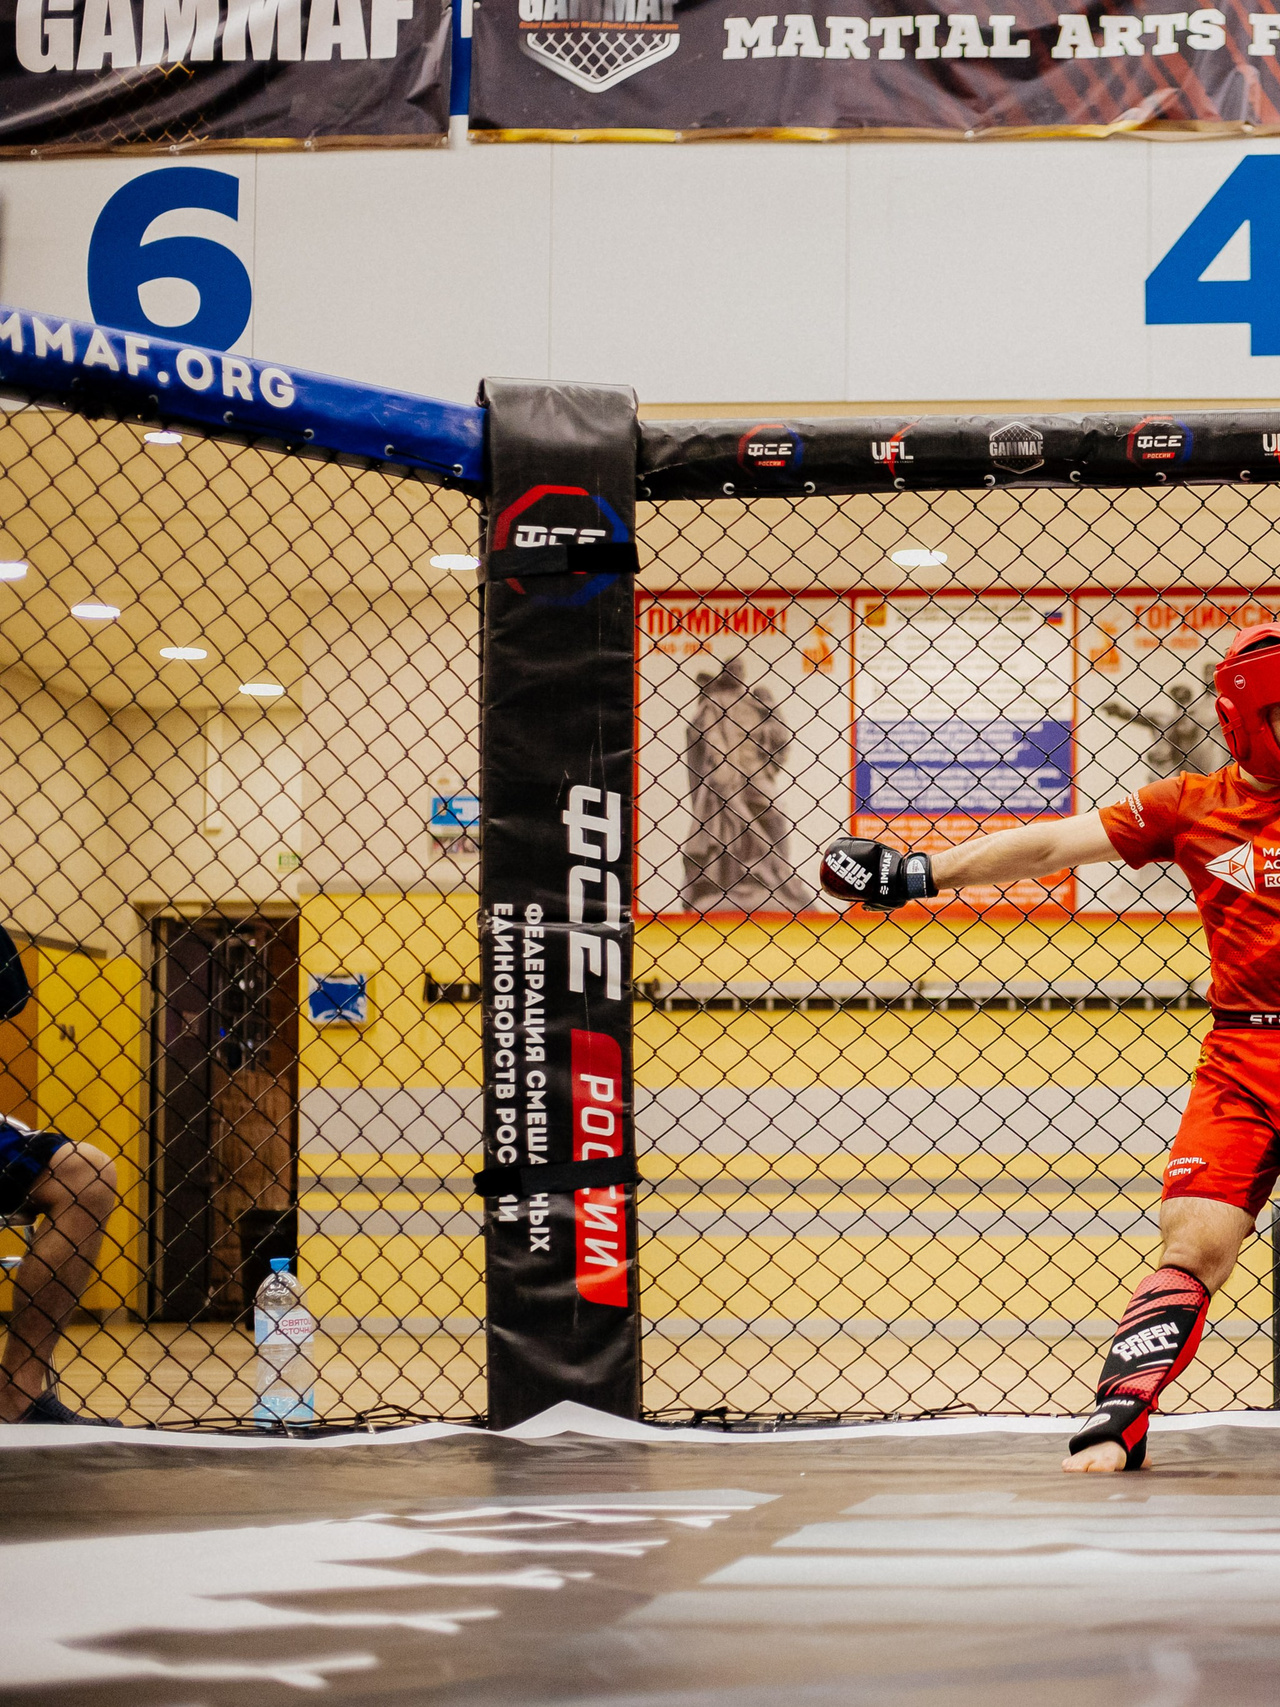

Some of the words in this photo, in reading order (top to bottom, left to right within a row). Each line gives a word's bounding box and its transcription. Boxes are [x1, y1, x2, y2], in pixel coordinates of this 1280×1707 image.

[16, 0, 413, 73] GAMMAF
[723, 14, 1030, 61] MARTIAL
[1051, 10, 1226, 59] ARTS
[87, 166, 252, 352] 6
[748, 443, 793, 457] ФСЕ
[872, 441, 914, 460] UFL
[989, 441, 1043, 456] GAMMAF
[1137, 435, 1183, 449] ФСЕ
[648, 607, 788, 636] ПОМНИМ!
[825, 853, 866, 891] GREEN
[836, 850, 873, 884] HILL
[880, 851, 893, 884] IMMAF
[562, 785, 622, 1001] ФСЕ
[523, 903, 546, 1062] ФЕДЕРАЦИЯ
[492, 903, 517, 1100] ЕДИНОБОРСТВ
[495, 1107, 519, 1222] РОСИ
[525, 1070, 551, 1252] СМЕШАНЫХ
[1167, 1156, 1206, 1169] ATIONAL
[1169, 1167, 1192, 1177] TEAM
[1112, 1322, 1180, 1354] GREEN
[1120, 1336, 1178, 1361] HILL
